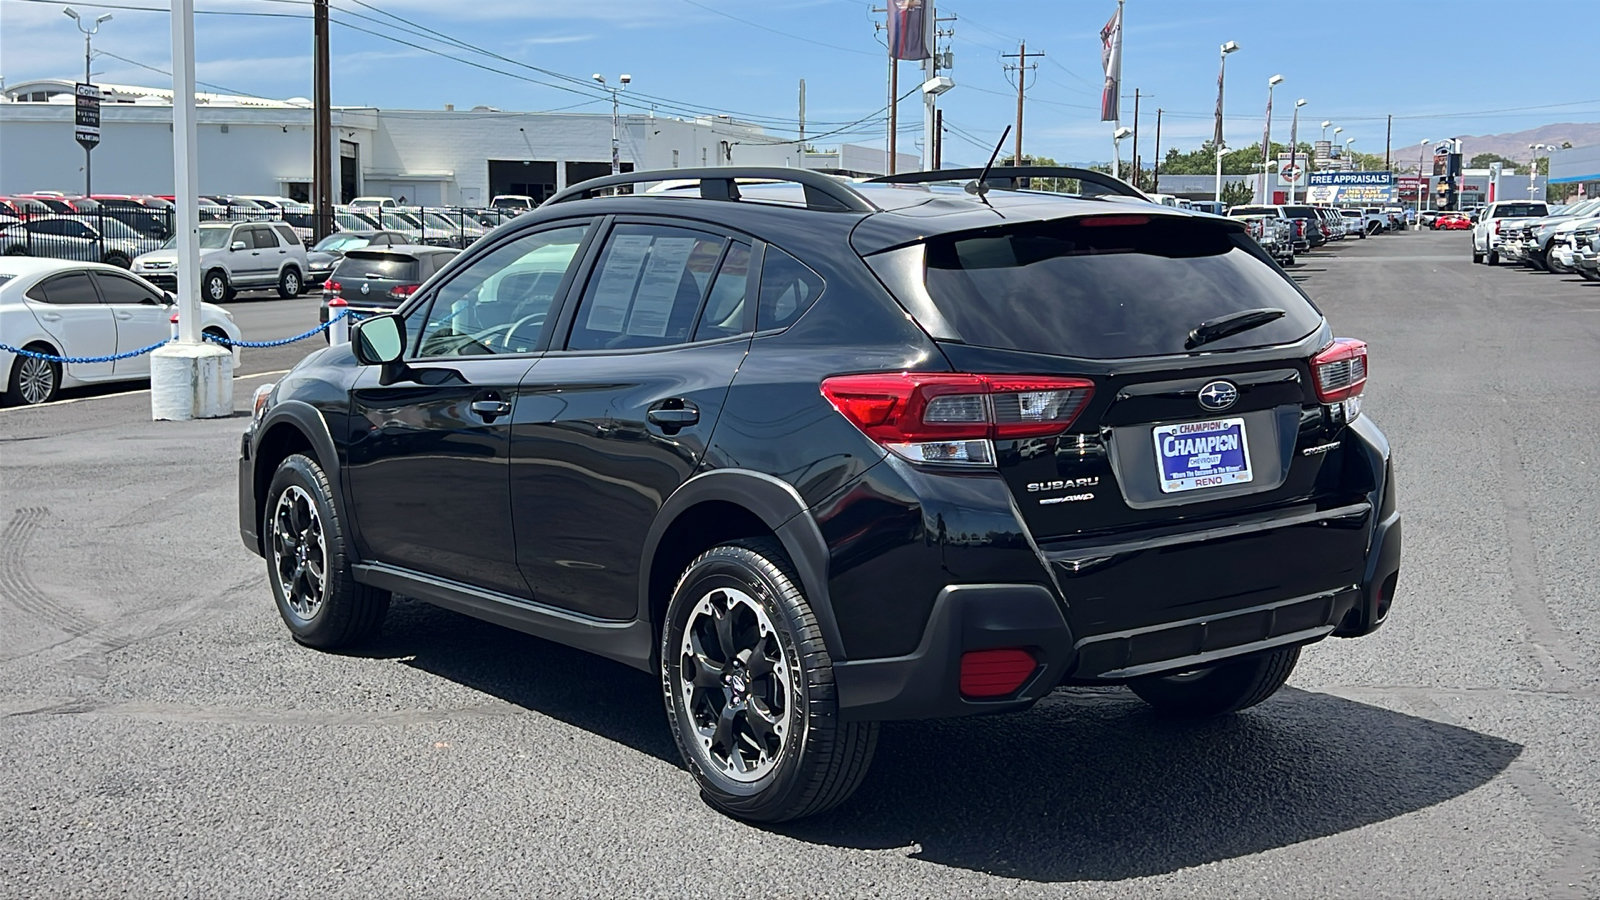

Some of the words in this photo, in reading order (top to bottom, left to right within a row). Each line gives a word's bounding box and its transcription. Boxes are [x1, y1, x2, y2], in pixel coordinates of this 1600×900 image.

[1311, 175, 1333, 184] FREE
[1333, 174, 1390, 183] APPRAISALS!
[1179, 422, 1222, 434] CHAMPION
[1163, 433, 1238, 457] CHAMPION
[1189, 456, 1219, 466] CHEVROLET
[1027, 476, 1099, 492] SUBARU
[1195, 476, 1223, 487] RENO
